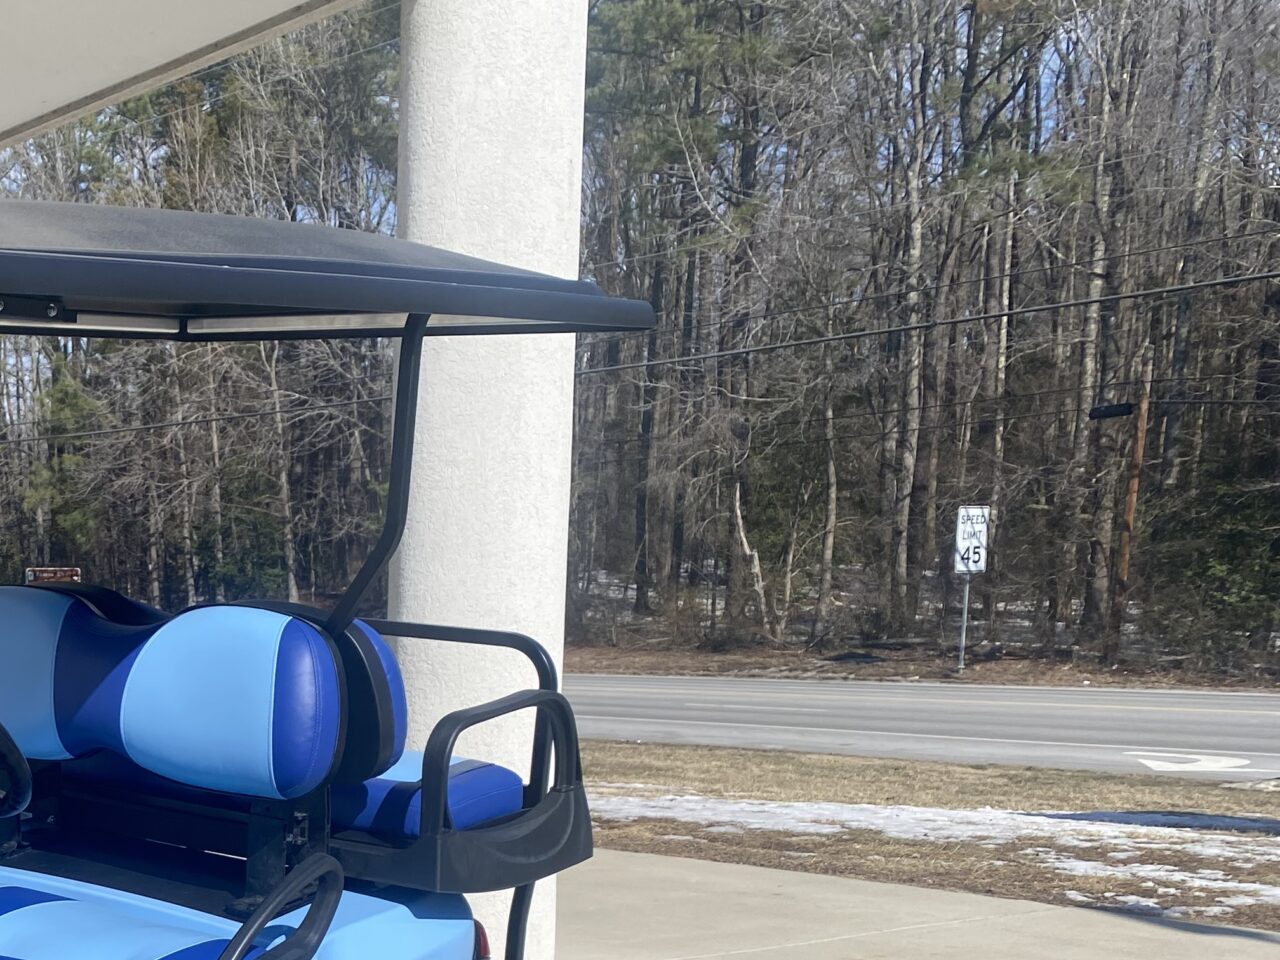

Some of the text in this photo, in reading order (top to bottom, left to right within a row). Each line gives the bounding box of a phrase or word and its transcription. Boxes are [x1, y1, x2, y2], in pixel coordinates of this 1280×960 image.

[961, 515, 986, 525] SPEED
[962, 531, 982, 540] LIMIT
[961, 546, 981, 564] 45
